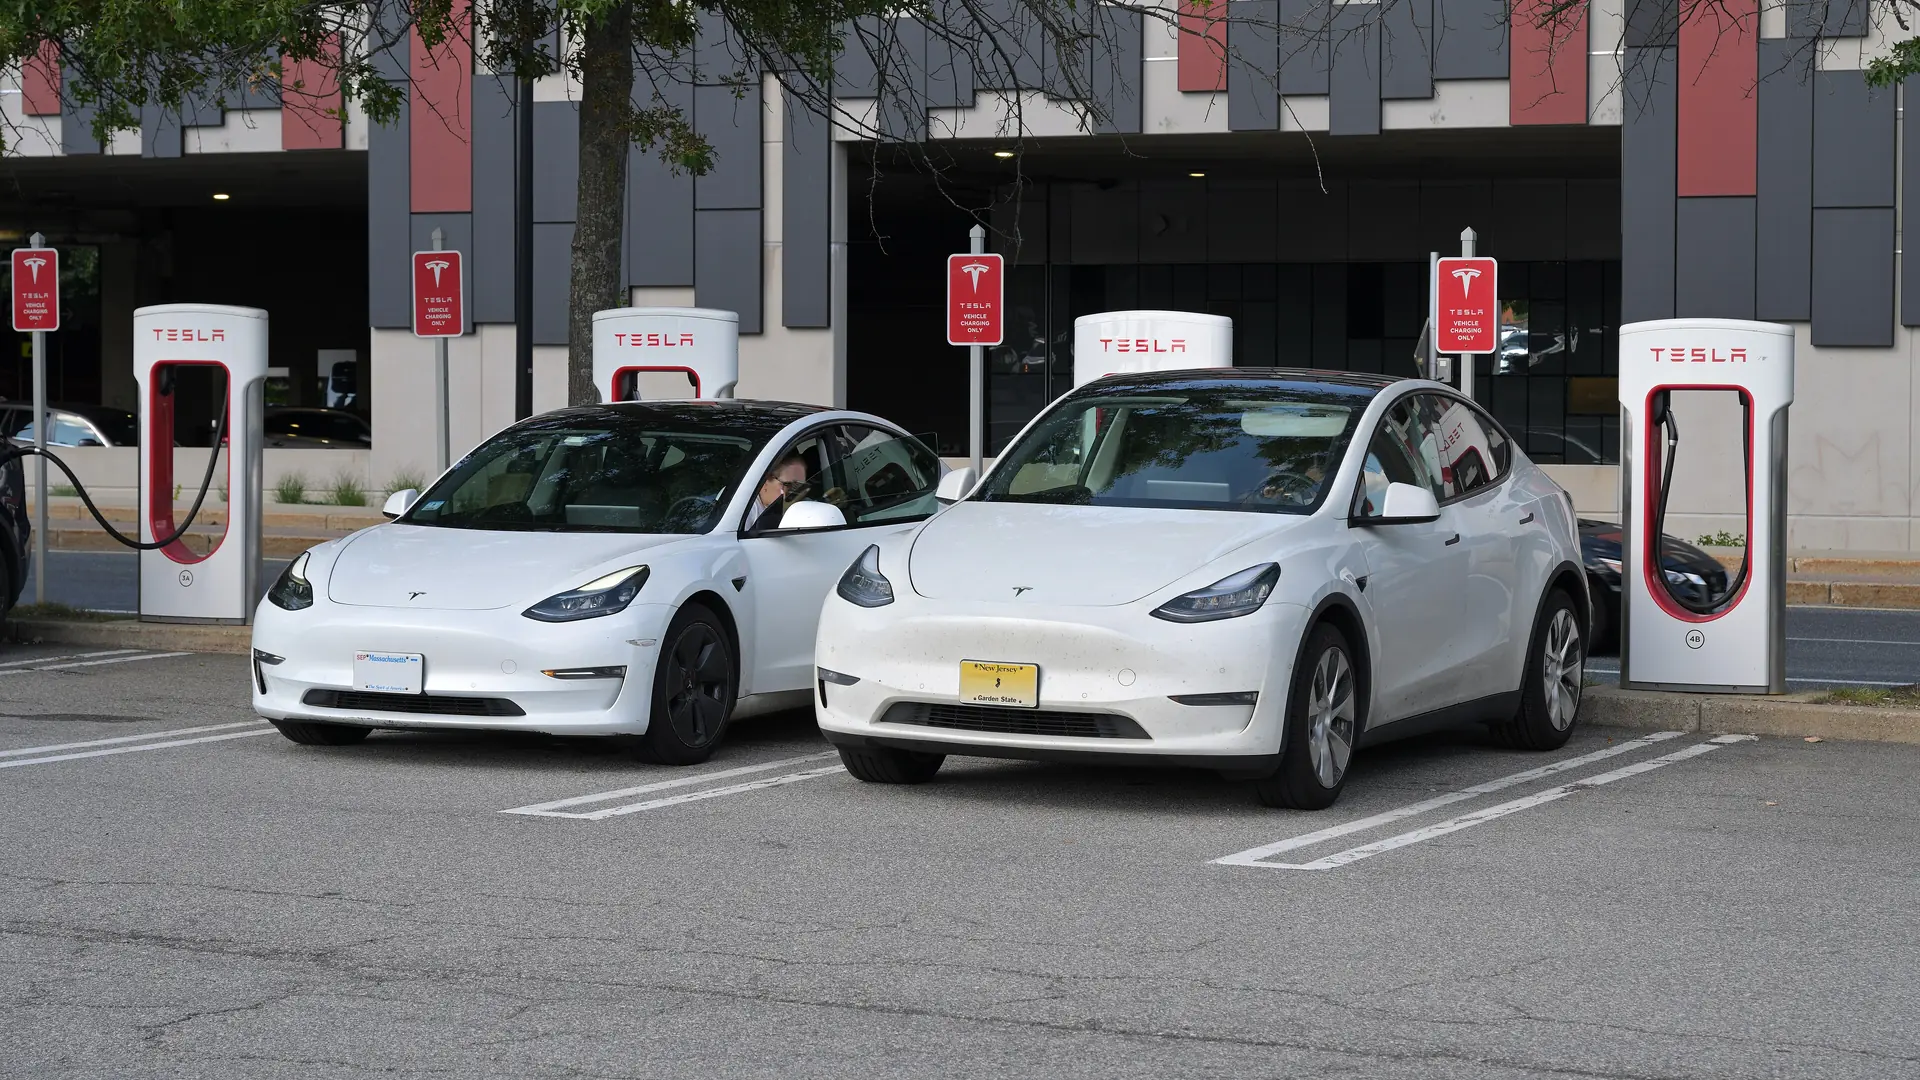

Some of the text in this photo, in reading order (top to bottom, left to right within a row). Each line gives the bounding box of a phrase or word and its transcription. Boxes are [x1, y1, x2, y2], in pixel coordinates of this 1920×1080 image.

[1449, 308, 1484, 316] TESLA
[152, 328, 225, 342] TESLA
[614, 333, 694, 347] TESLA
[1099, 338, 1186, 353] TESLA
[1649, 347, 1747, 363] TESLA
[369, 653, 407, 664] Massachusetts
[978, 663, 1018, 674] New Jersey
[977, 694, 1017, 704] Garden State
